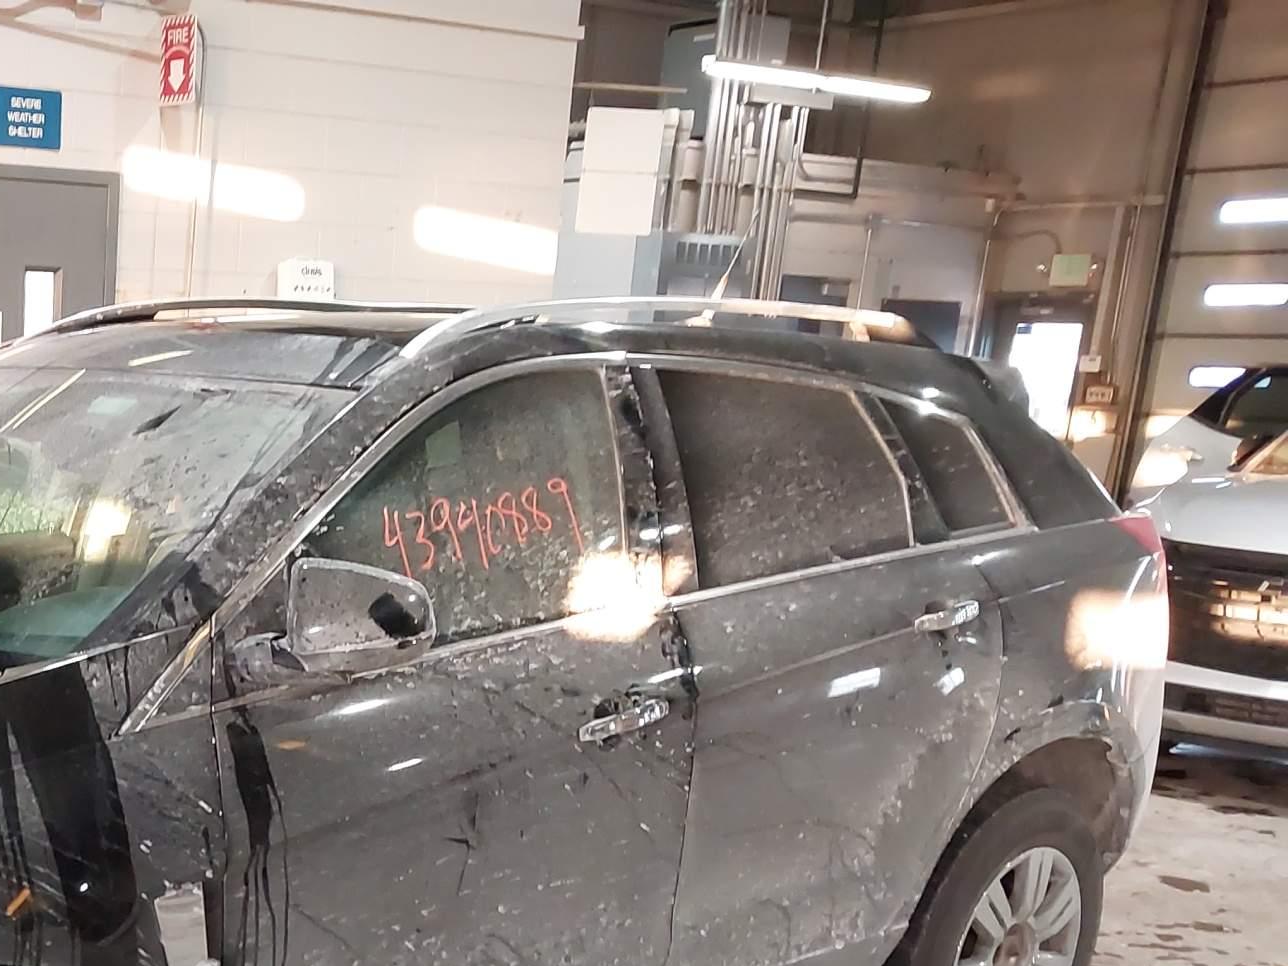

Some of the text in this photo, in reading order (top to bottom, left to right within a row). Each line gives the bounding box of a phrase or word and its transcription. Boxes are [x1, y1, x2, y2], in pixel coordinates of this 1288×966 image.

[167, 27, 189, 46] FIRE
[10, 96, 42, 110] SEVERE
[7, 110, 45, 125] WEATHER
[8, 125, 44, 139] SHELTER
[384, 477, 584, 580] 43940889
